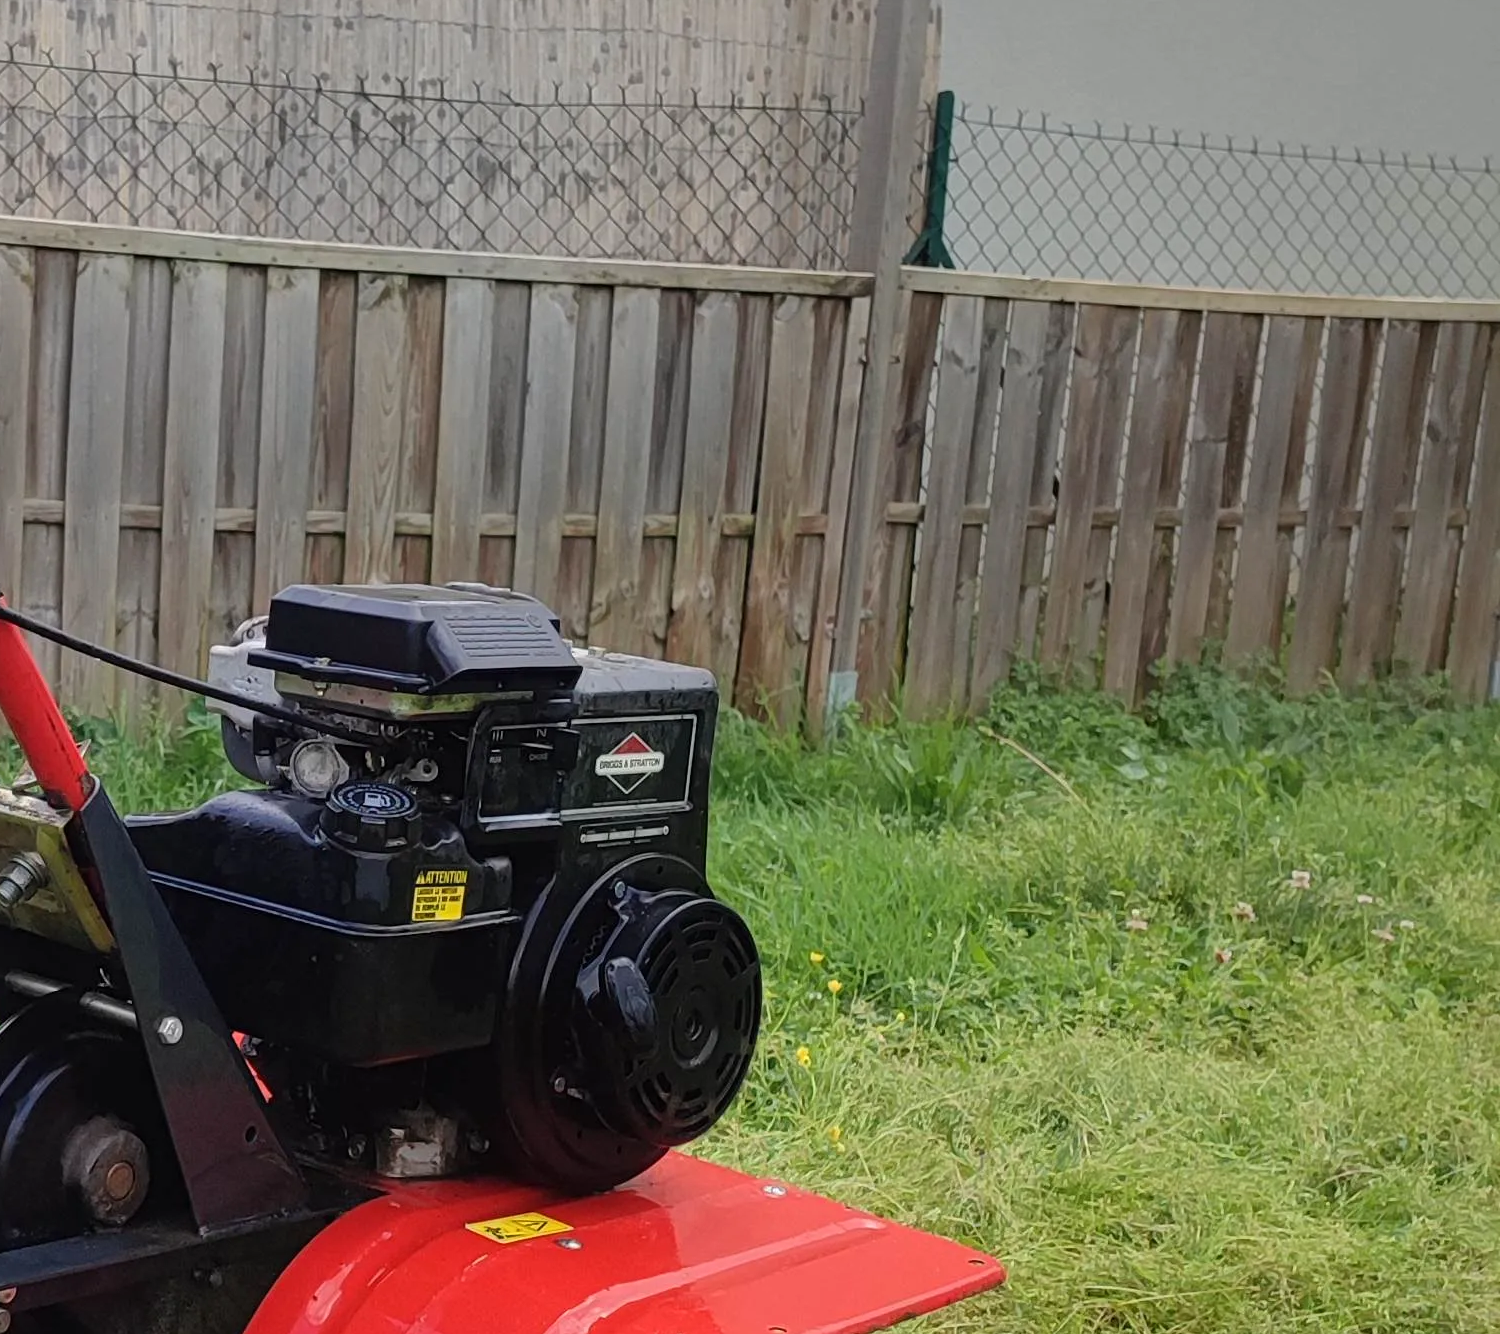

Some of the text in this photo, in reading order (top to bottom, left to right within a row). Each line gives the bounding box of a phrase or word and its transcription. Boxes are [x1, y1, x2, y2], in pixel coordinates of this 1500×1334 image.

[599, 758, 661, 769] BRIGGS & STRATTON
[425, 870, 468, 884] ATTENTION
